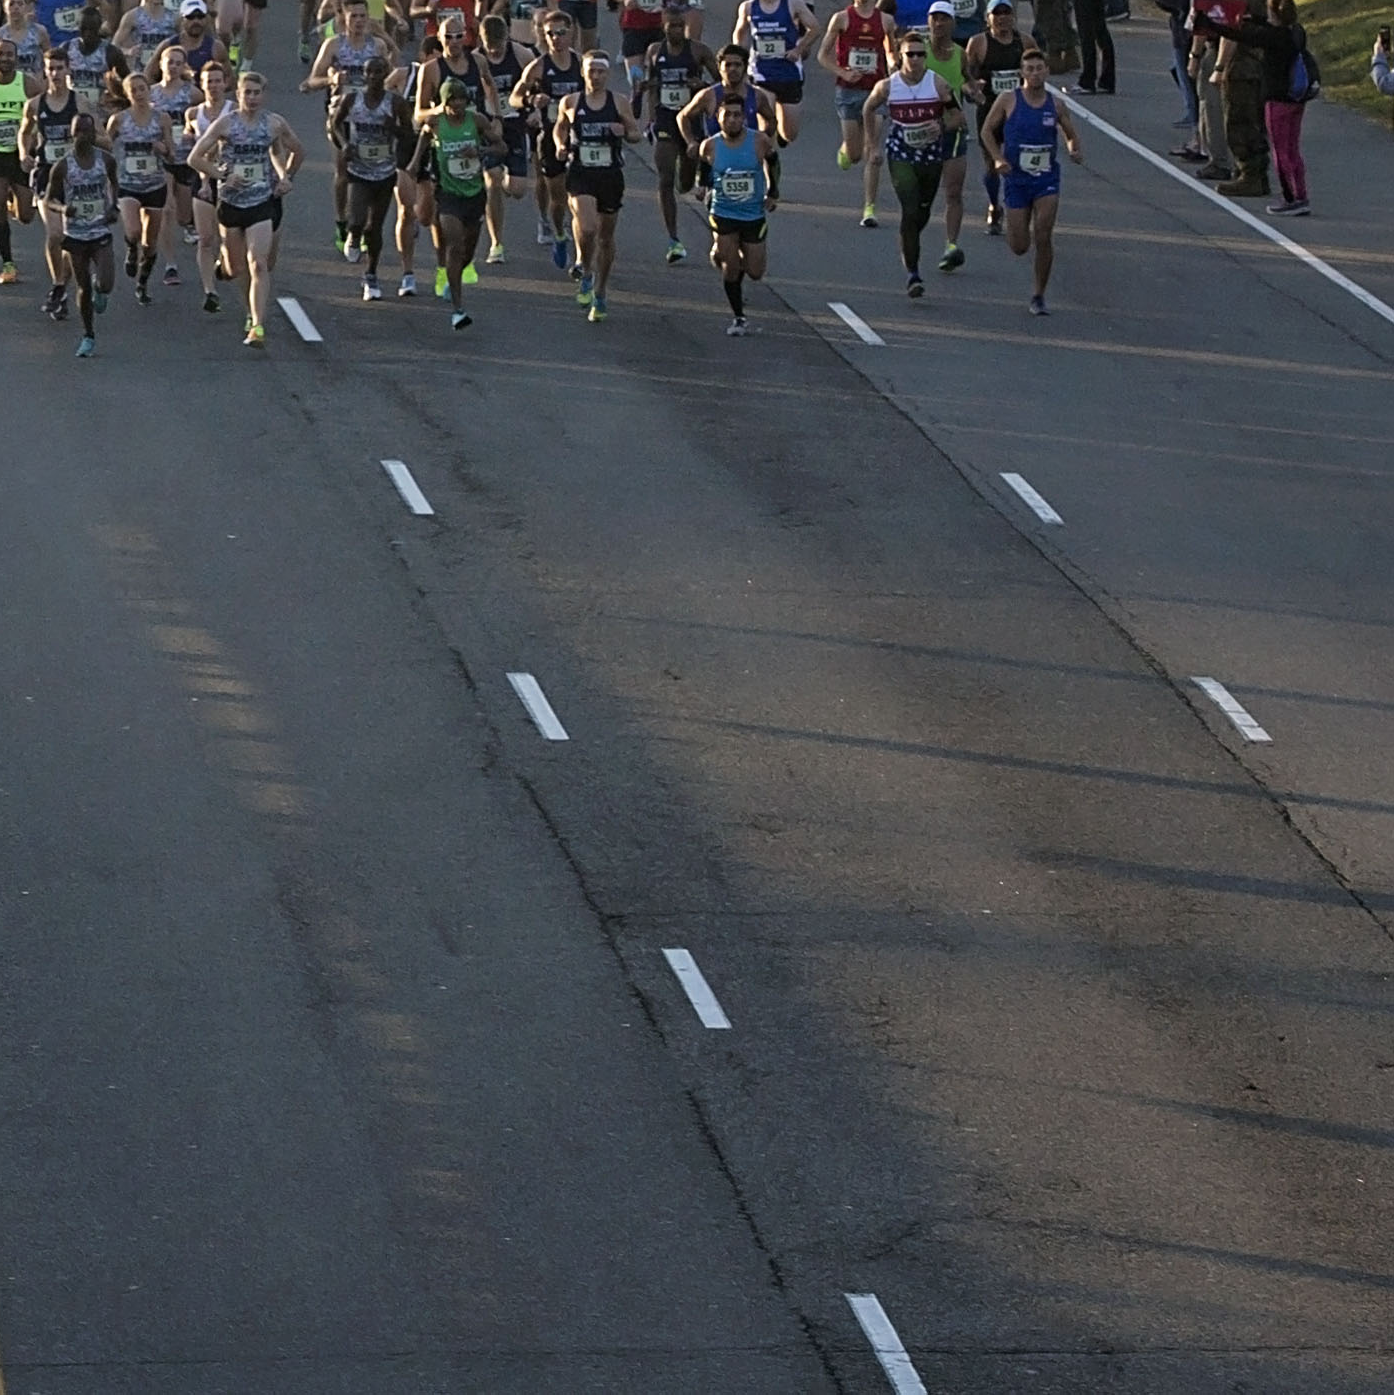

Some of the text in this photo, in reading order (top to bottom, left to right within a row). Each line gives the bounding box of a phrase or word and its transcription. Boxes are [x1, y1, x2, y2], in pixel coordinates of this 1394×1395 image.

[765, 43, 776, 53] 22
[669, 92, 681, 102] 64
[590, 151, 601, 162] 61
[725, 180, 749, 193] 5358
[82, 203, 94, 215] 50
